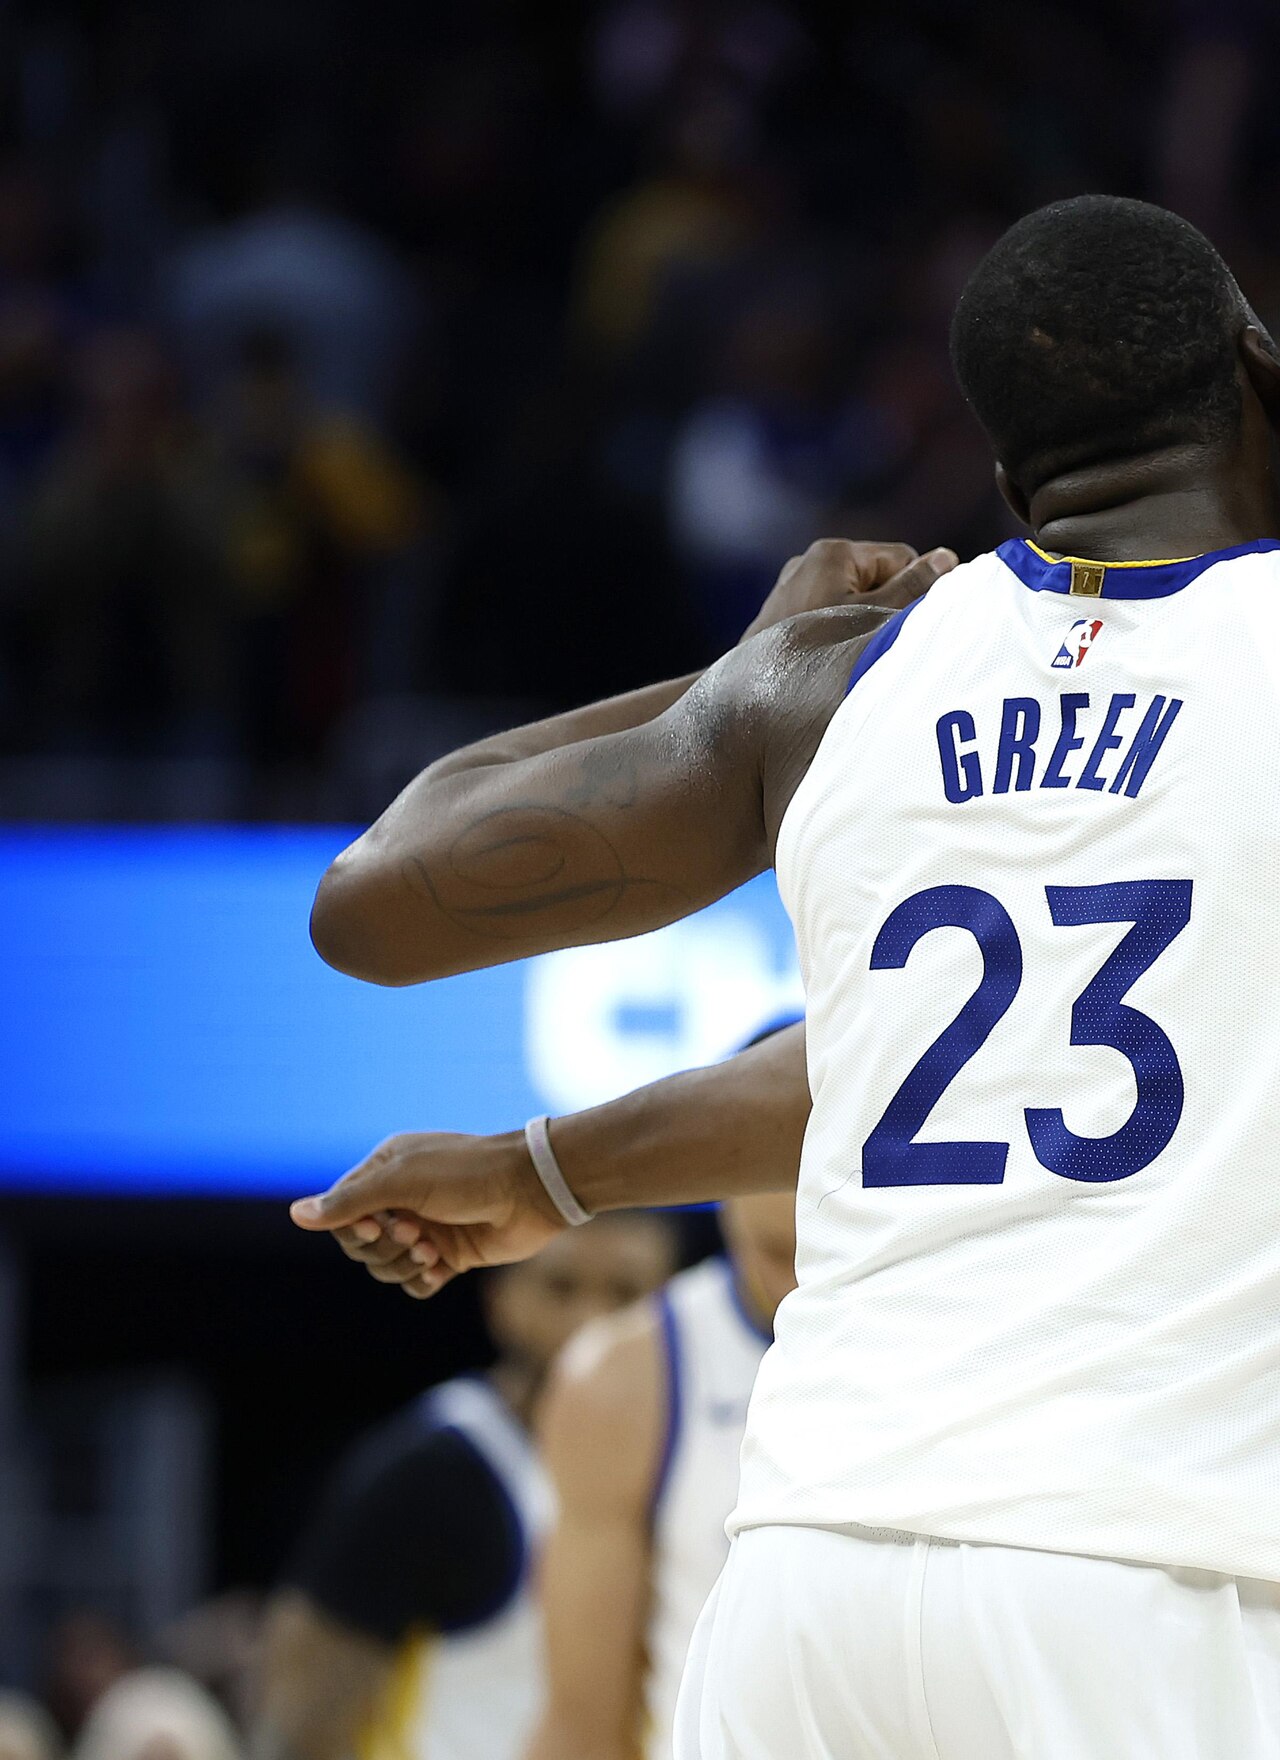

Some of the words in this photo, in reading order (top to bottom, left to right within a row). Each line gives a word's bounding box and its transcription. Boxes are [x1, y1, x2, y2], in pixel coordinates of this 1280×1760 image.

[1053, 655, 1072, 666] NBA
[936, 692, 1184, 804] GREEN
[861, 879, 1194, 1188] 23
